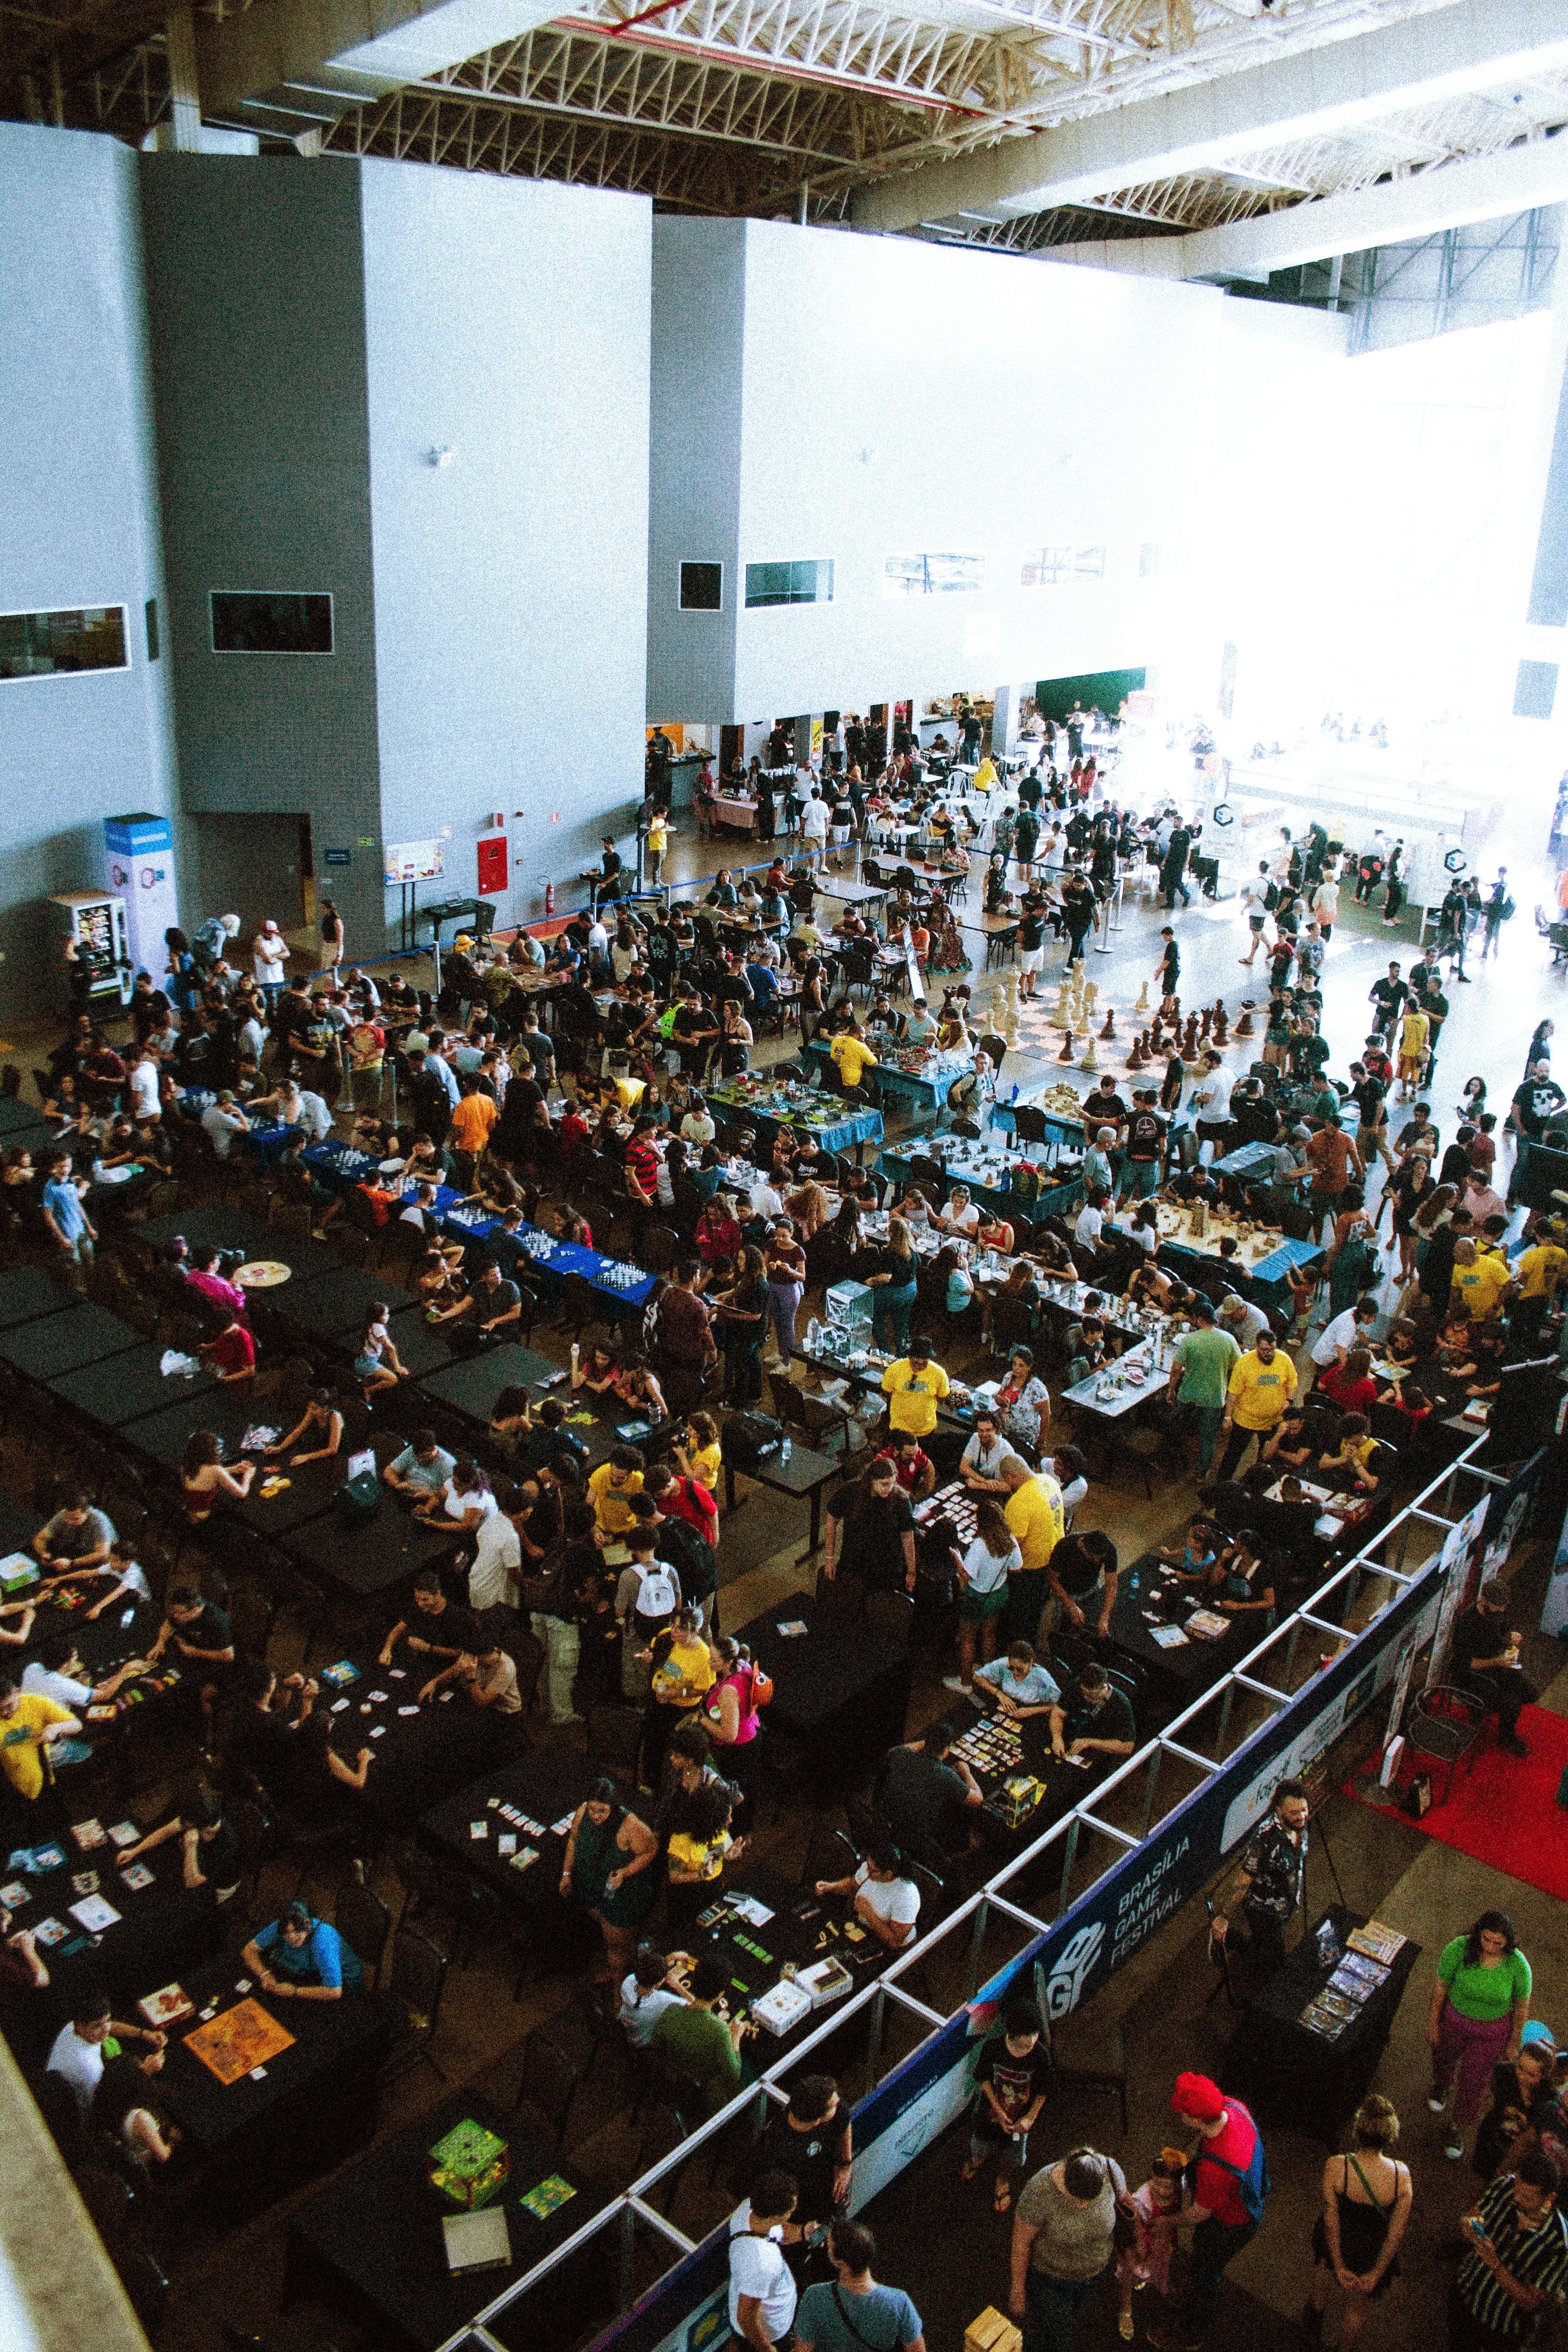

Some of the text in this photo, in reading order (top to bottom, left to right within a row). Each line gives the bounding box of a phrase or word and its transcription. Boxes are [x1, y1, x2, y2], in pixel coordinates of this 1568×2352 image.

[1114, 1884, 1161, 1940] GAME
[1117, 1836, 1190, 1916] BRASÍLIA
[1110, 1887, 1182, 1967] FESTIVAL
